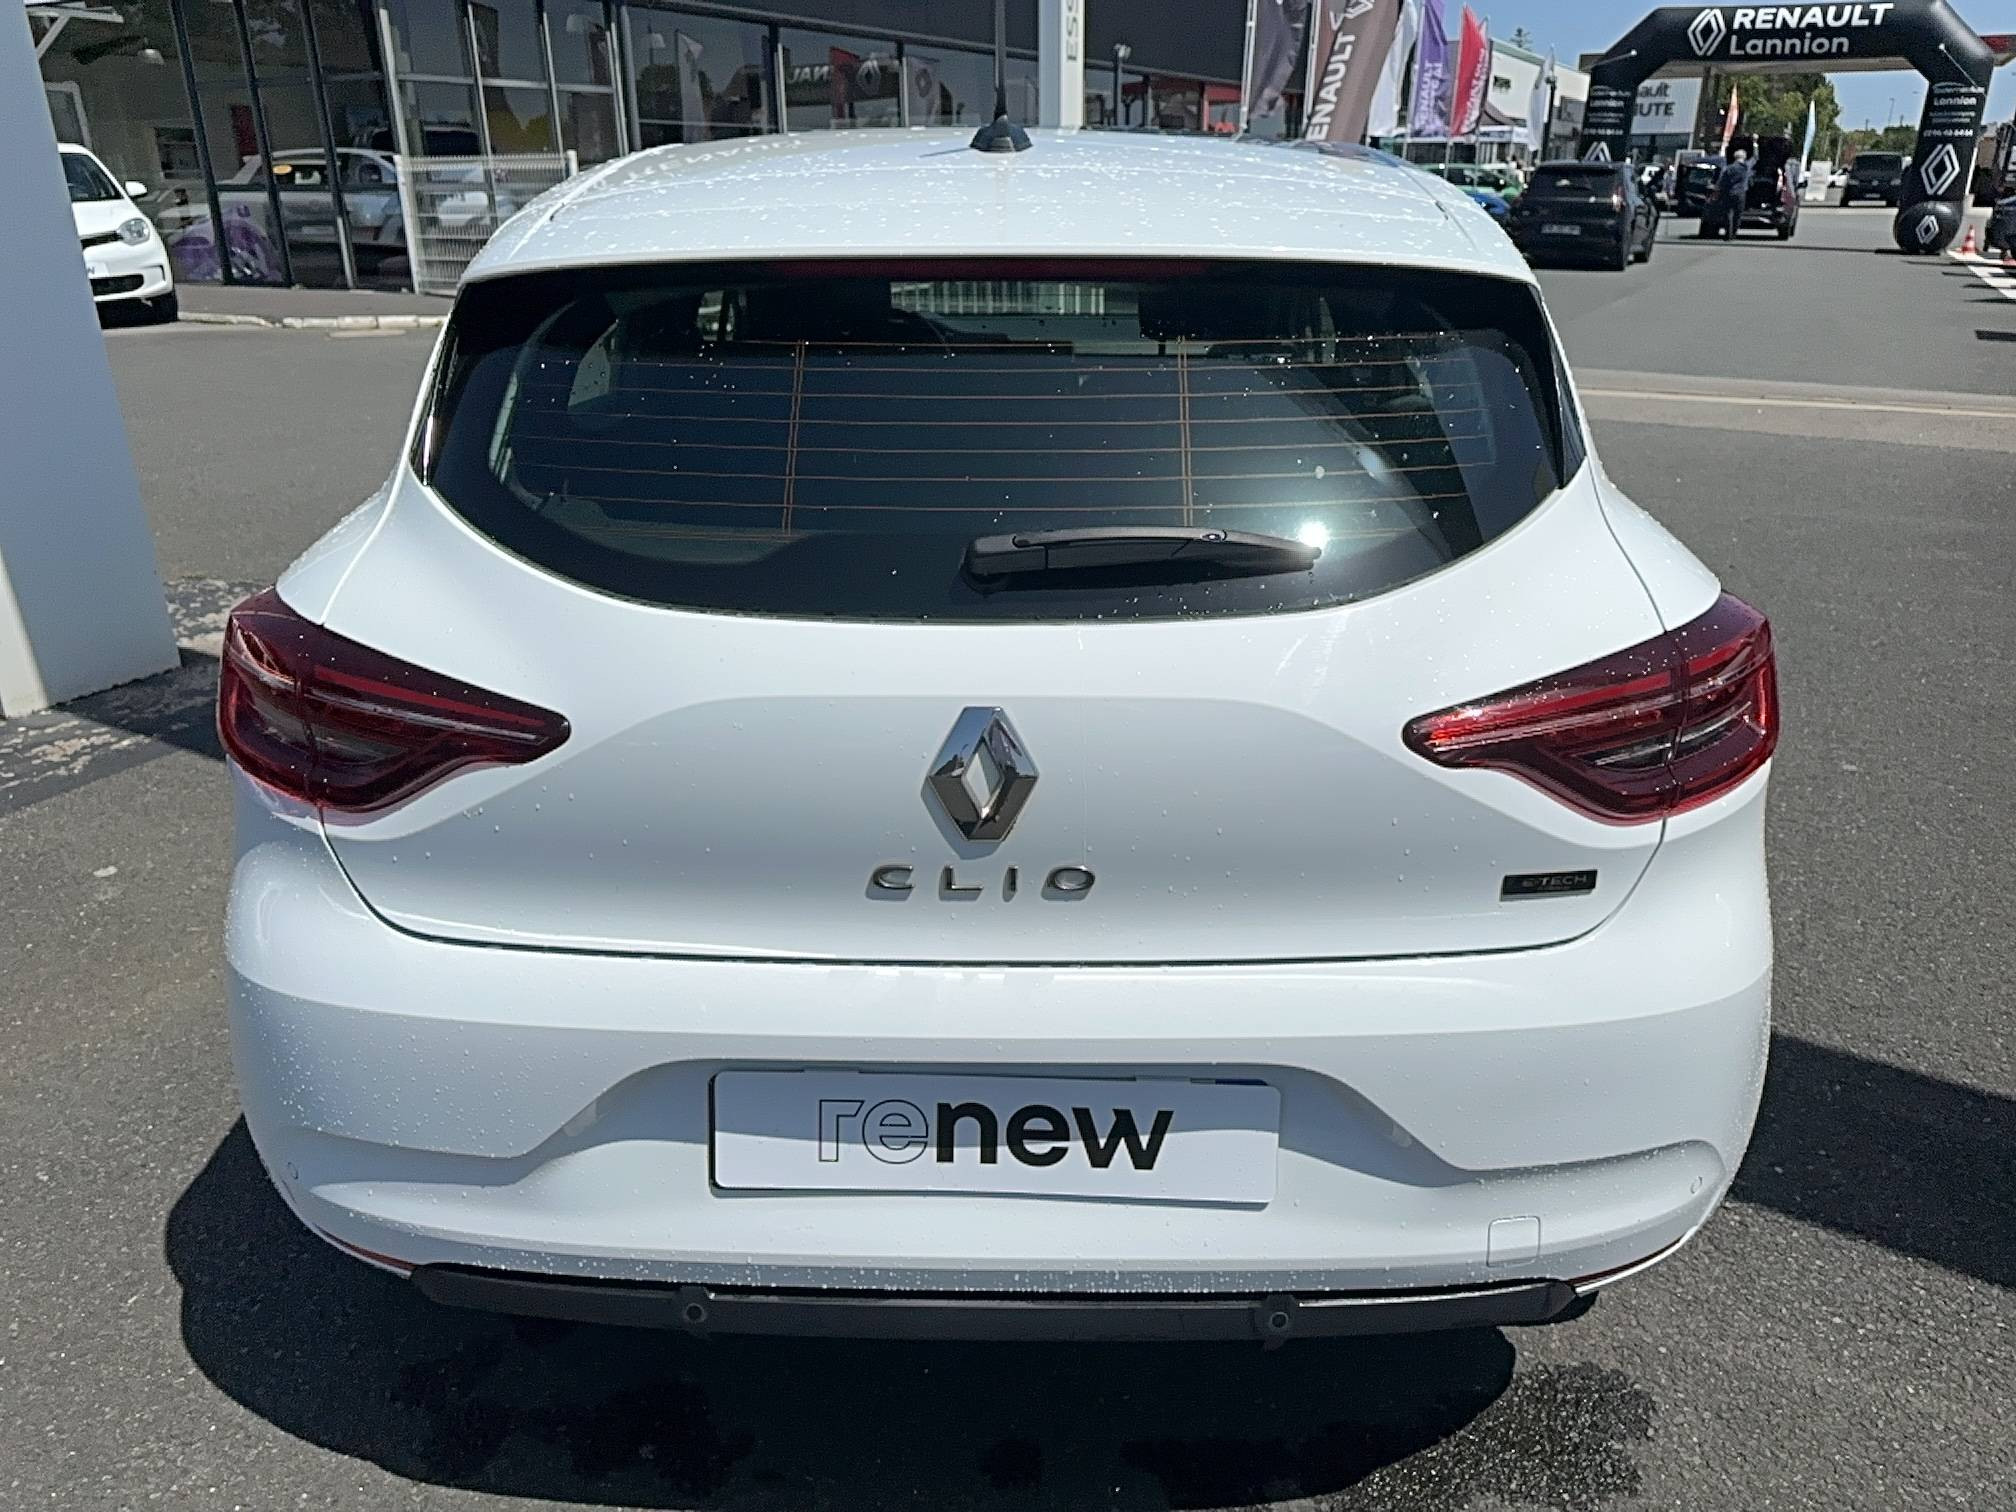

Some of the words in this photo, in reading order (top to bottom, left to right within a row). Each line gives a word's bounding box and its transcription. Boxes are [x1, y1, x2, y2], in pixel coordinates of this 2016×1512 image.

[1733, 3, 1894, 30] RENAULT
[1729, 31, 1849, 56] Lannion
[1305, 32, 1356, 141] ENAULT
[867, 864, 1097, 898] CLIO
[818, 1099, 1175, 1171] renew
